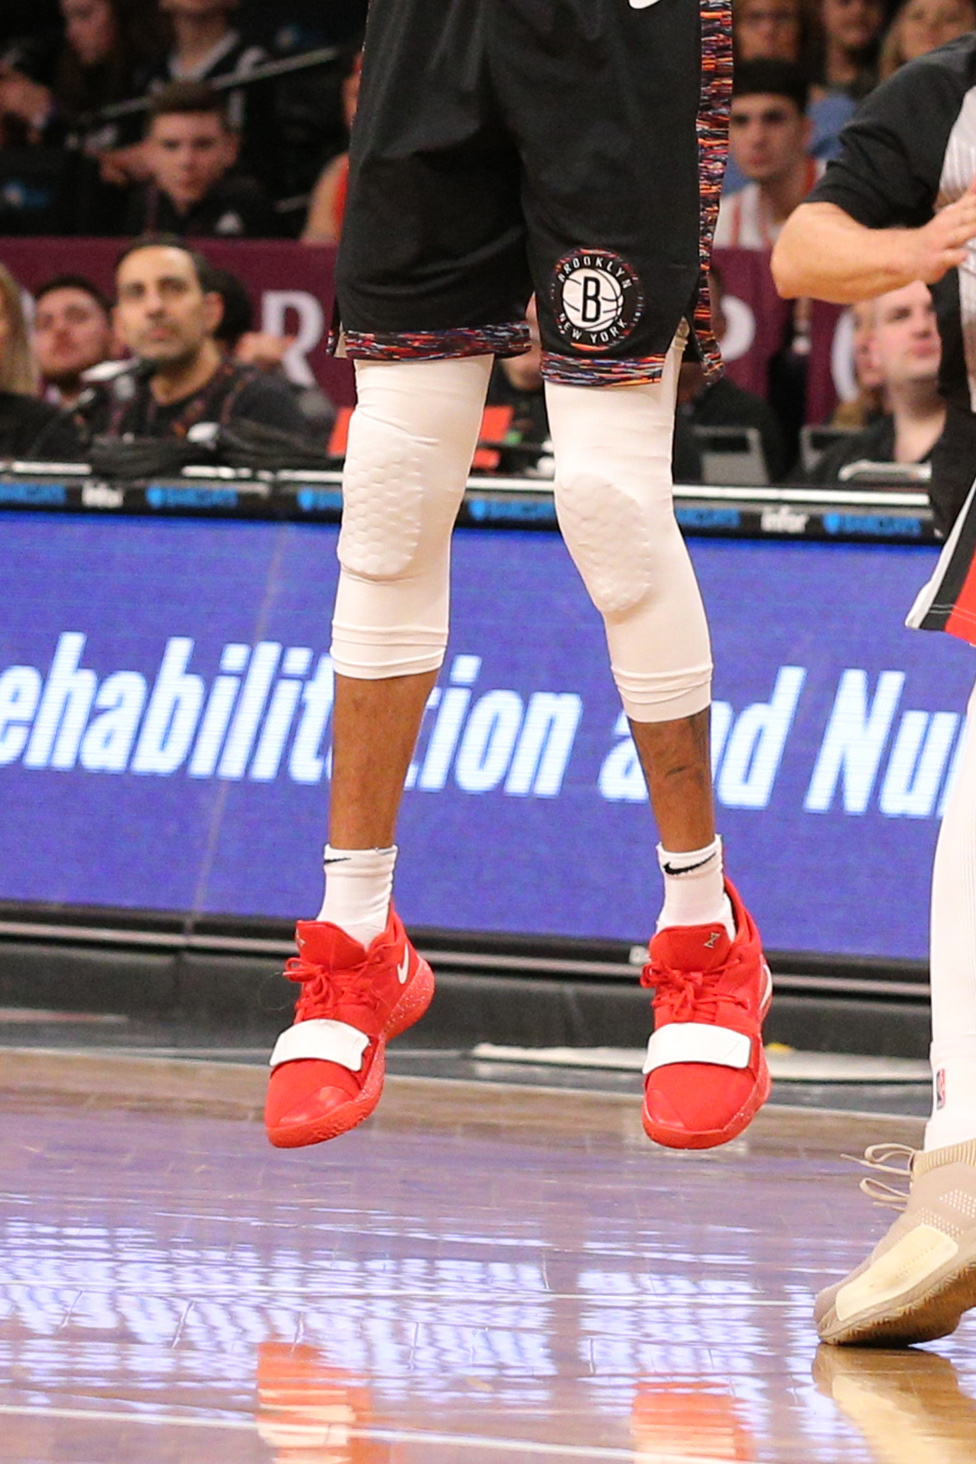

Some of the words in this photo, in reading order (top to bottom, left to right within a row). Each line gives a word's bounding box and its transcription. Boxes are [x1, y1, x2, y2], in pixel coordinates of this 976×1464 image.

[557, 255, 632, 289] BROOKLYN
[582, 276, 601, 323] B
[559, 312, 582, 340] NEW
[589, 318, 628, 344] YORK
